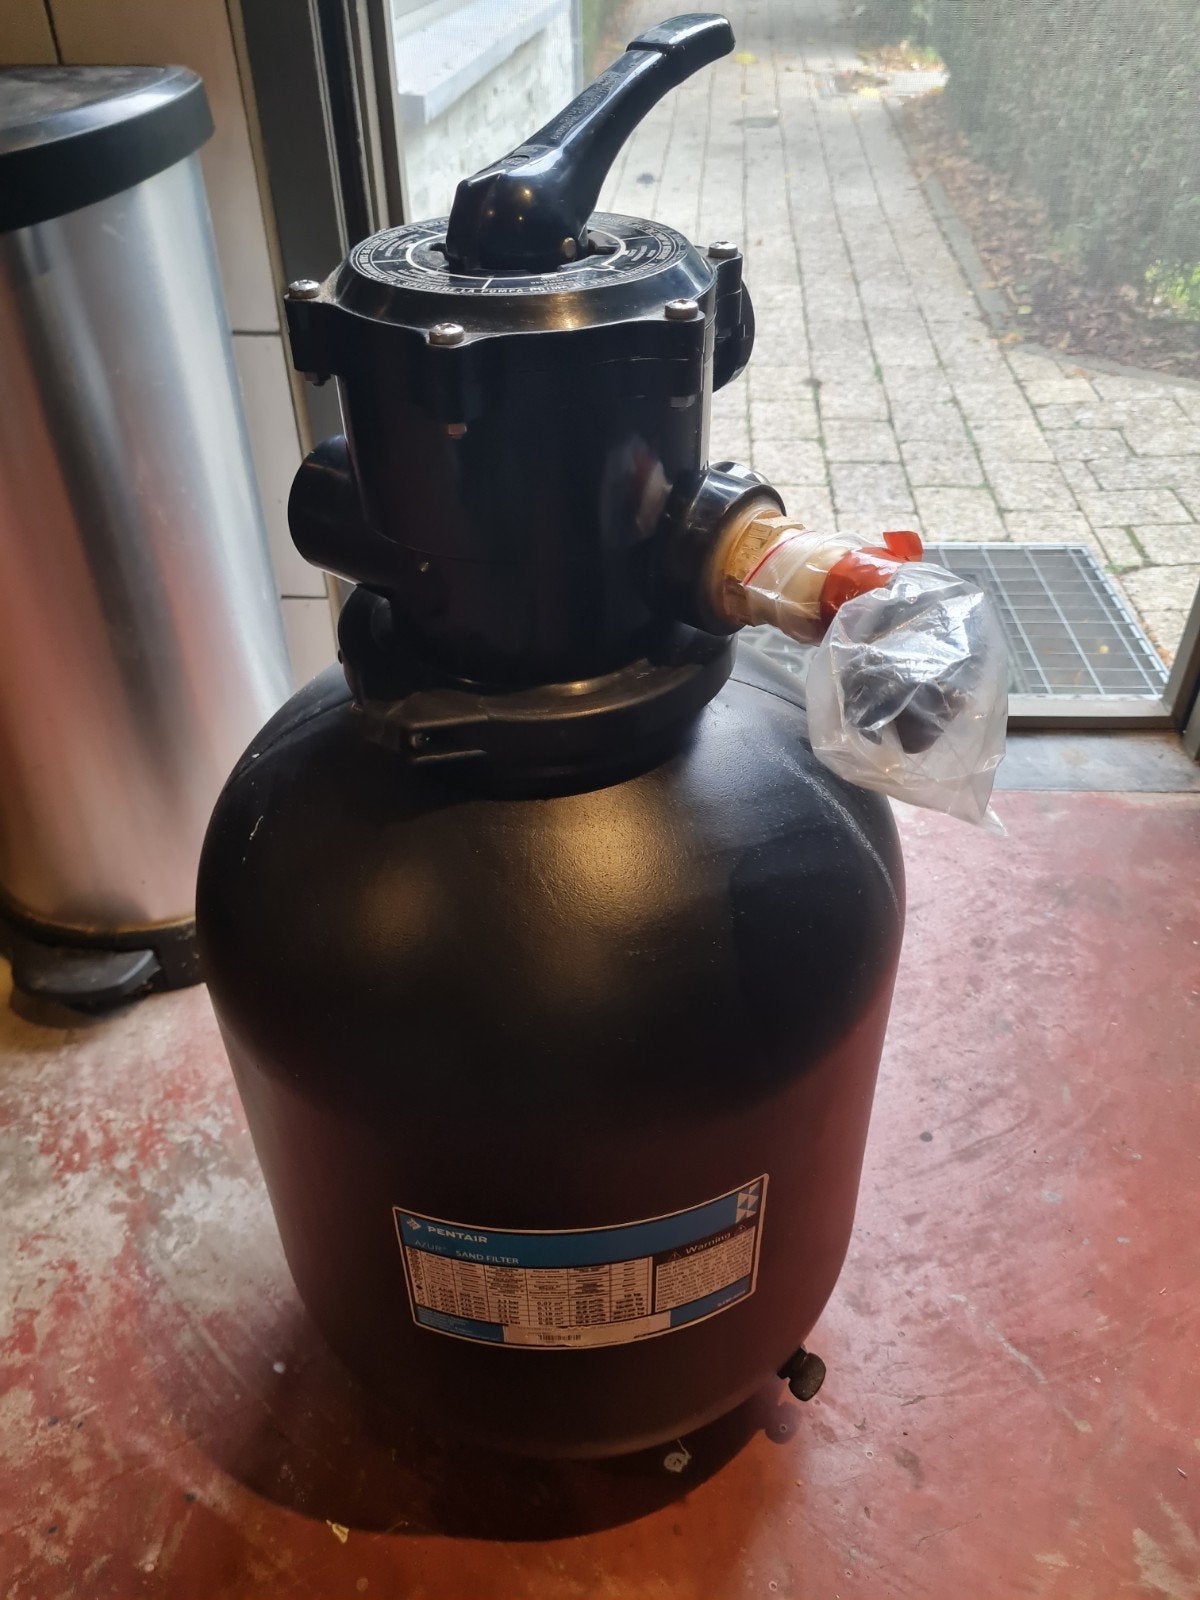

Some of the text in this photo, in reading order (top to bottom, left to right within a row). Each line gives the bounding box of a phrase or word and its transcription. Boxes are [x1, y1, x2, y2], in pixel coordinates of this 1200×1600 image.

[427, 1225, 488, 1244] PENTAIR
[685, 1231, 732, 1254] Warning
[455, 1250, 519, 1265] SAND FILTER
